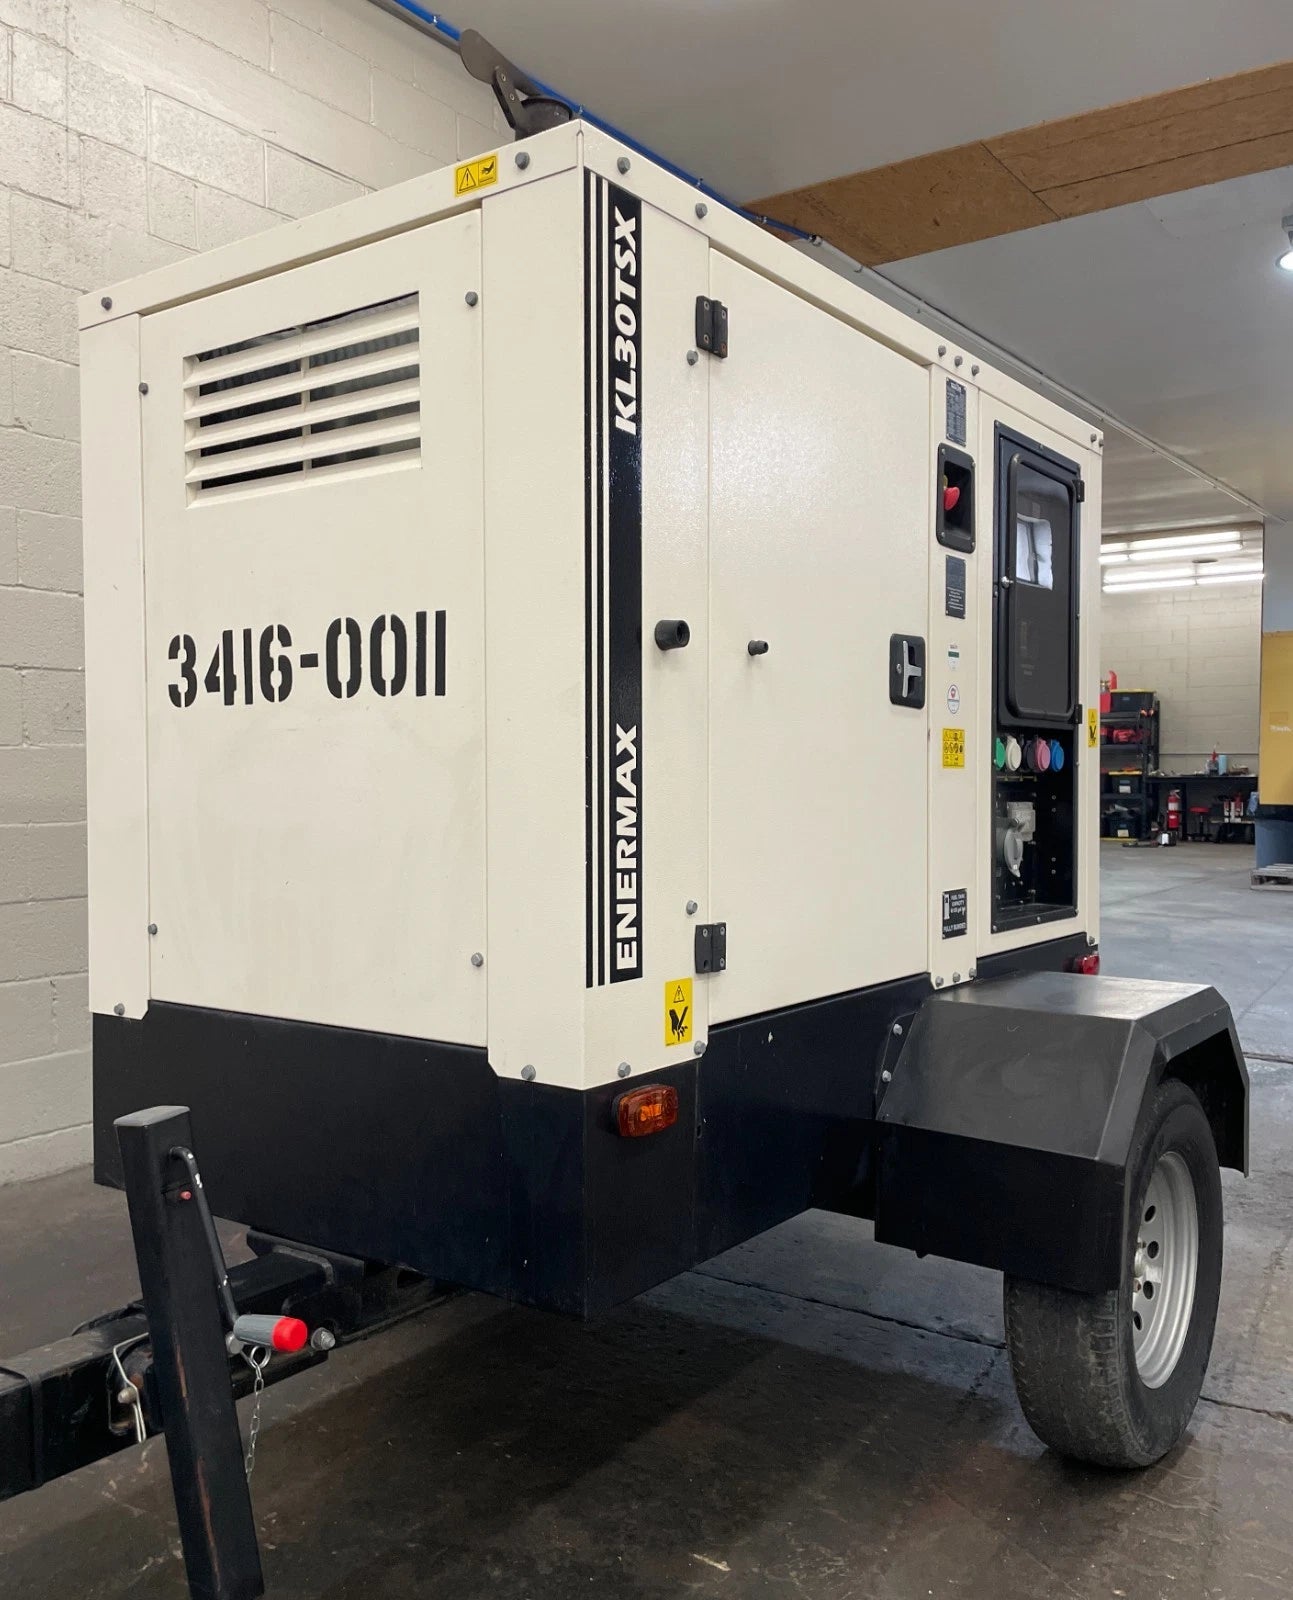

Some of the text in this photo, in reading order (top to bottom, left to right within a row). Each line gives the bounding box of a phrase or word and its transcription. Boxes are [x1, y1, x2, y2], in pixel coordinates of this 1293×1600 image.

[615, 206, 636, 435] KL30TSX
[168, 610, 446, 708] 3416-0011
[616, 723, 637, 970] ENERMAX
